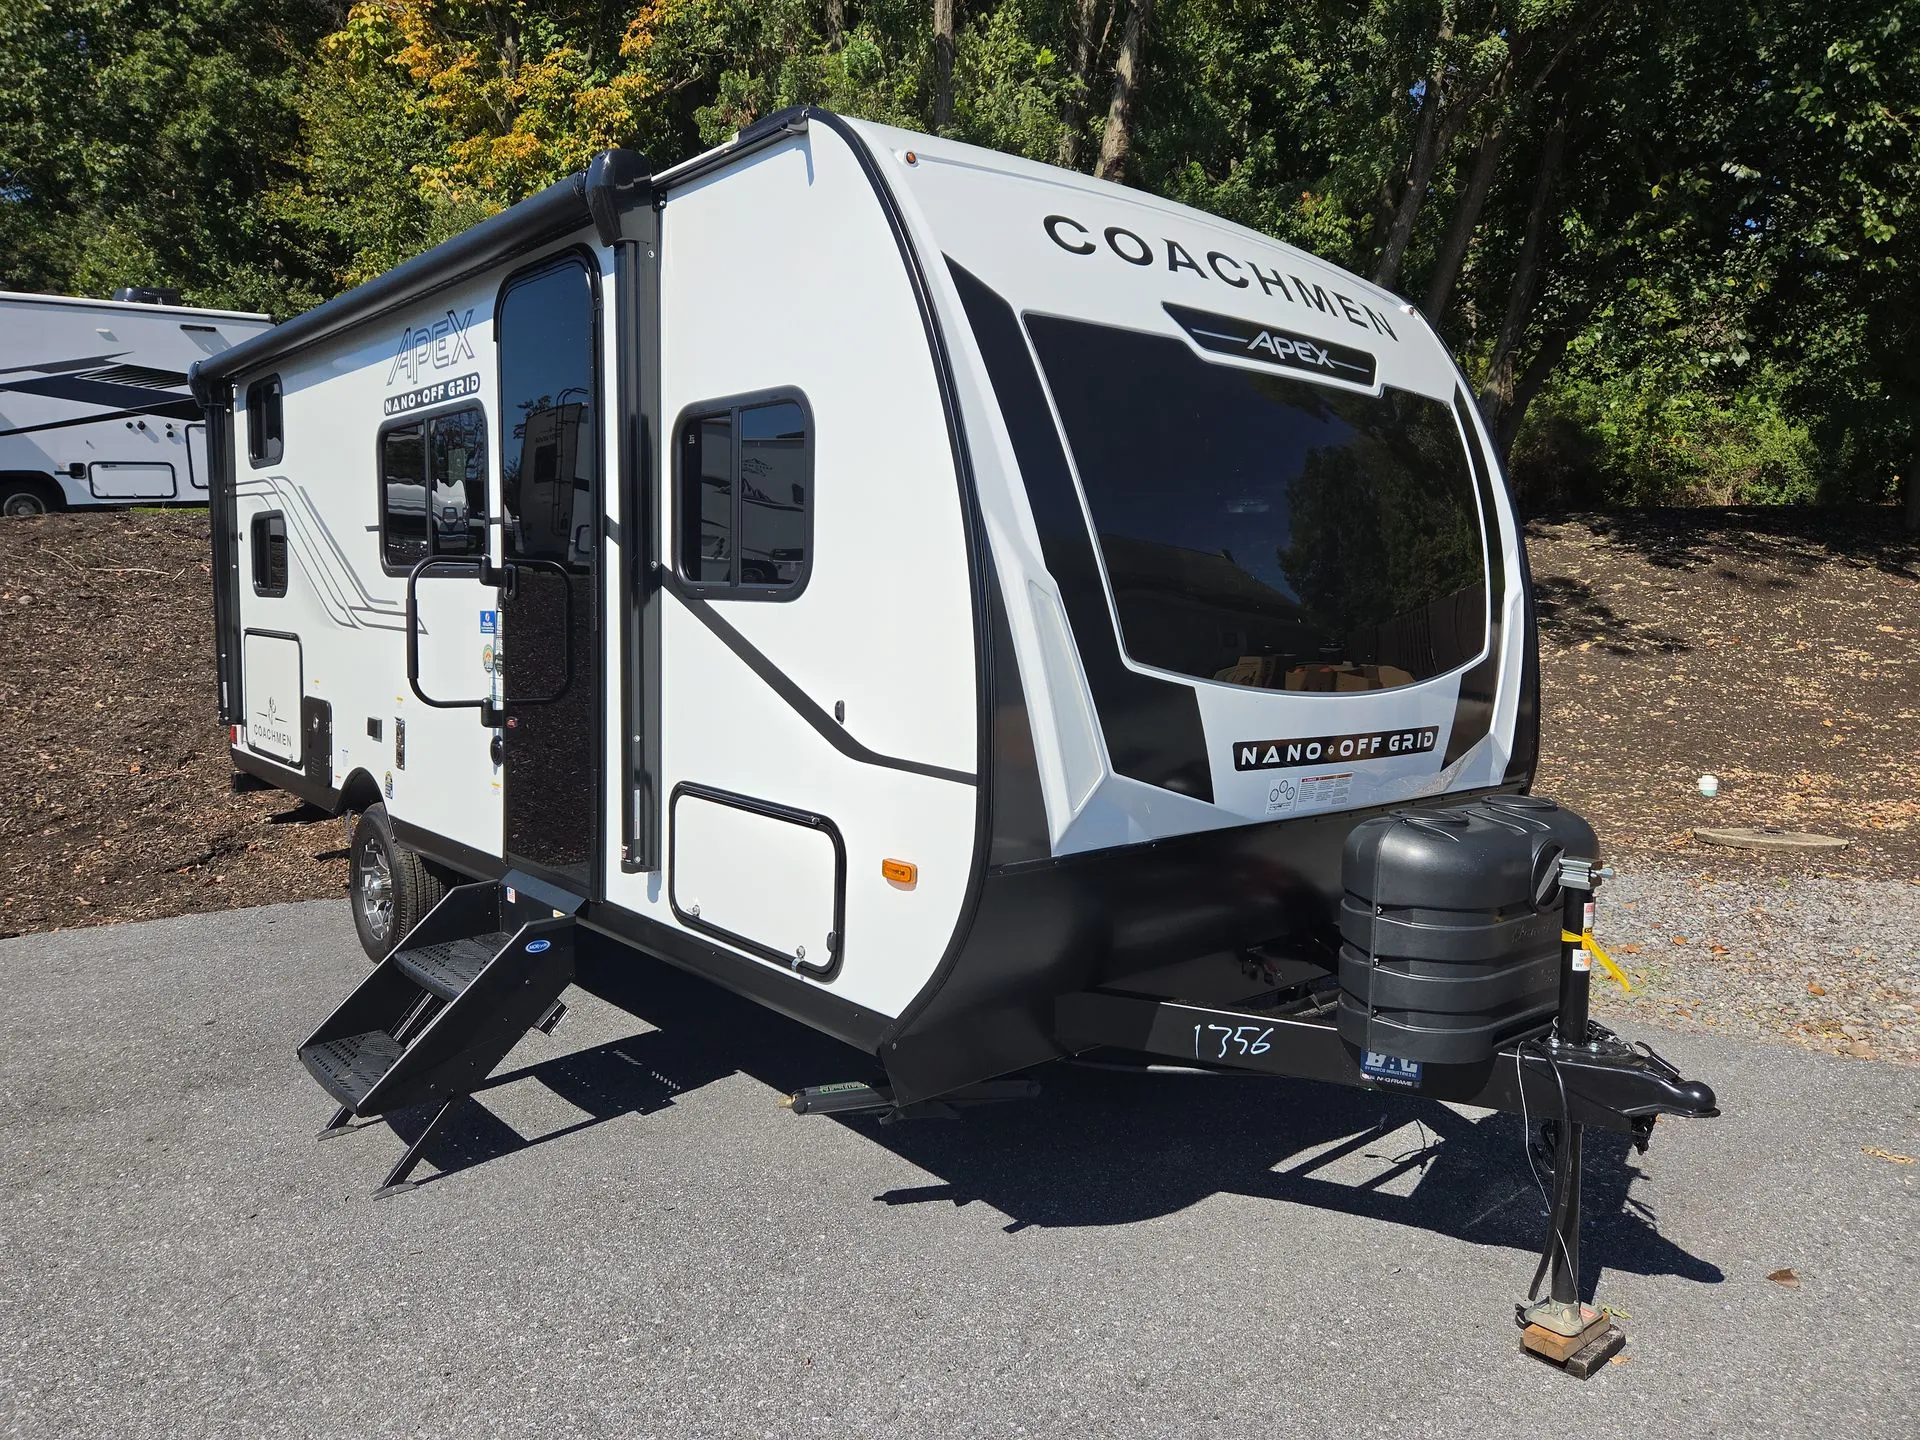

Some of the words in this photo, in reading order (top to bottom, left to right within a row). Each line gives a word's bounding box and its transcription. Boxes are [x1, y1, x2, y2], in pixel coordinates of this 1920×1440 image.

[1043, 214, 1400, 343] COACHMEN
[386, 308, 475, 386] APEX
[1247, 331, 1336, 368] APEX
[385, 394, 416, 414] NANO
[422, 384, 445, 404] OFF
[448, 375, 479, 396] GRID
[253, 724, 292, 747] COACHMEN
[1241, 744, 1322, 766] NANO
[1339, 736, 1382, 757] OFF
[1388, 731, 1434, 751] GRID
[1194, 1024, 1274, 1060] 1356
